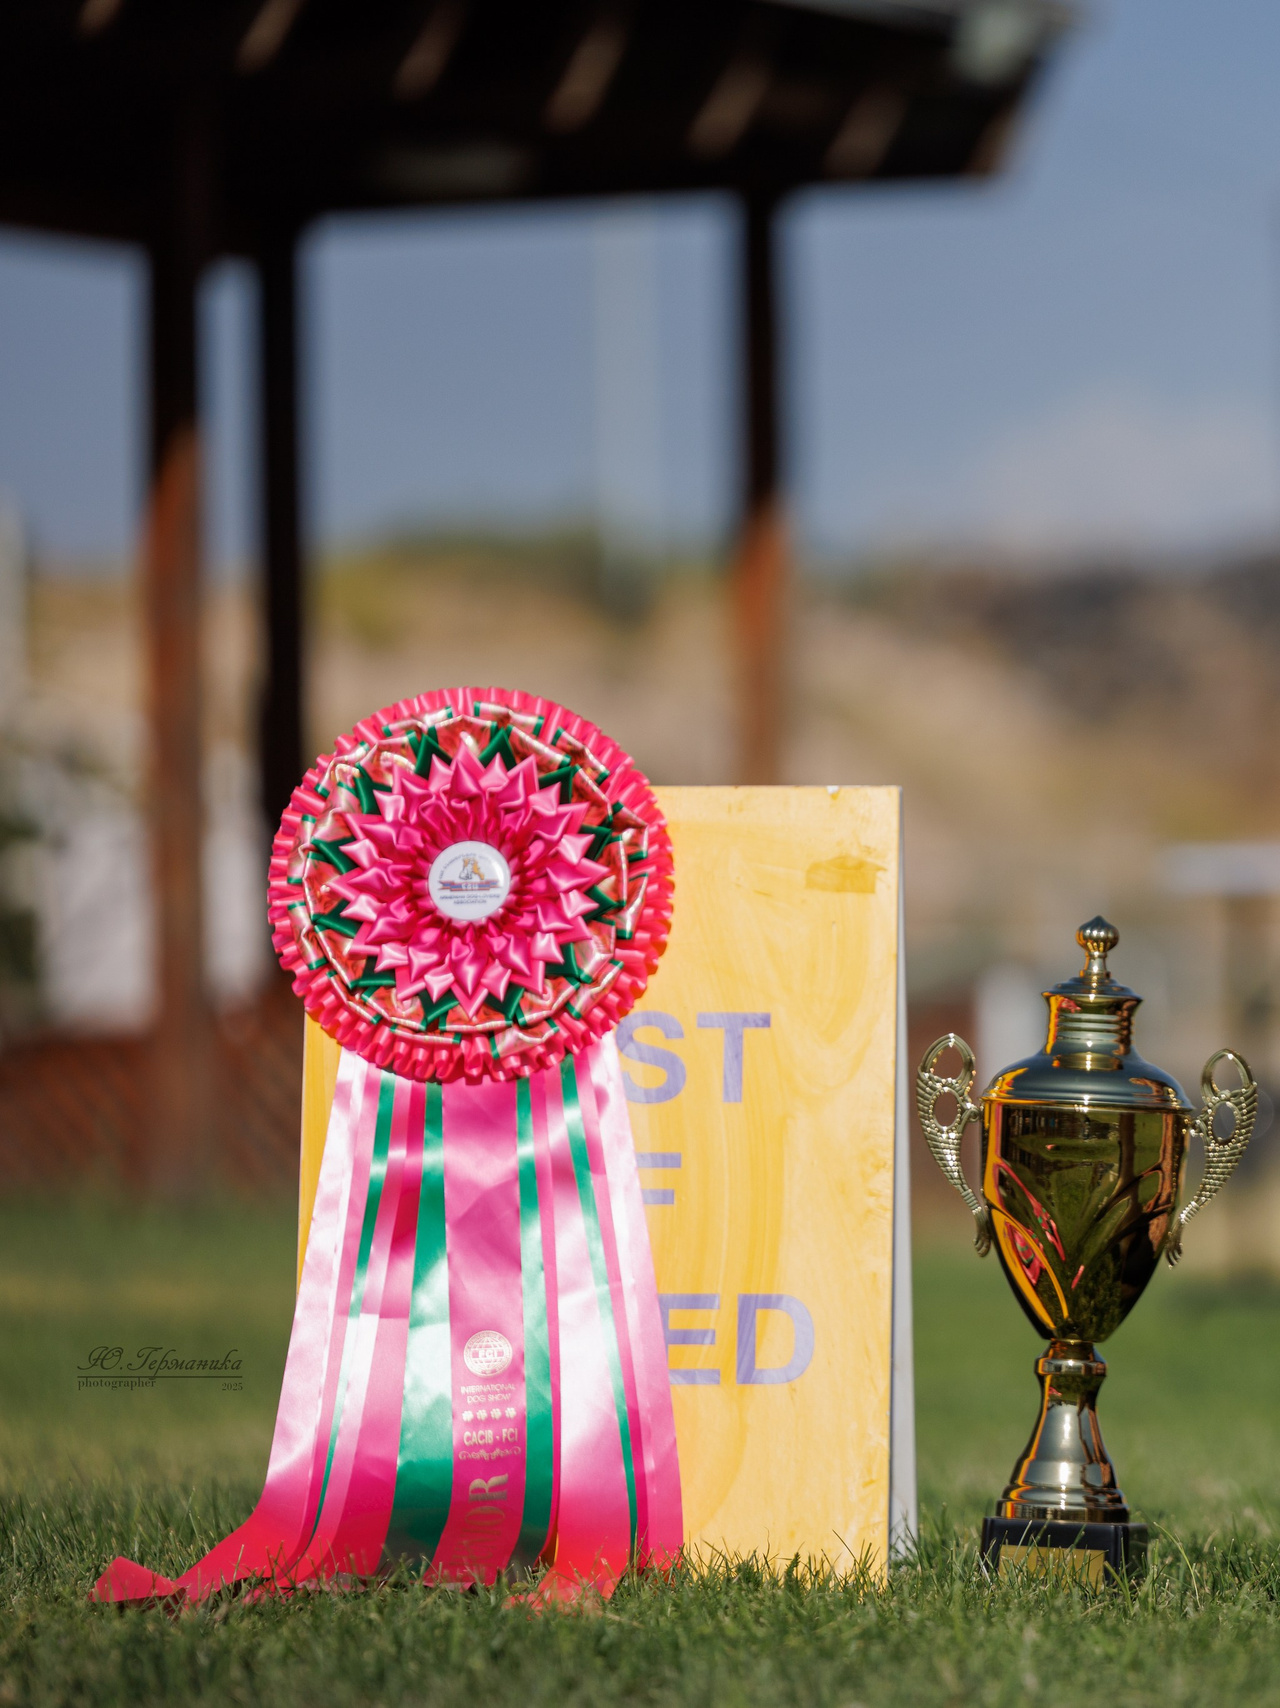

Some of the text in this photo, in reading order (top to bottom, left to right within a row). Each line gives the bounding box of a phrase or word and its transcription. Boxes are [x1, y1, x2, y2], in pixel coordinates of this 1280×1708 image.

[615, 1010, 771, 1104] ST
[636, 1152, 682, 1205] F
[478, 1348, 498, 1360] FCI
[460, 1384, 516, 1395] INTERNATIONAL
[466, 1393, 511, 1404] DOG SHOW
[463, 1429, 494, 1446] CACIB
[501, 1427, 519, 1443] FCI
